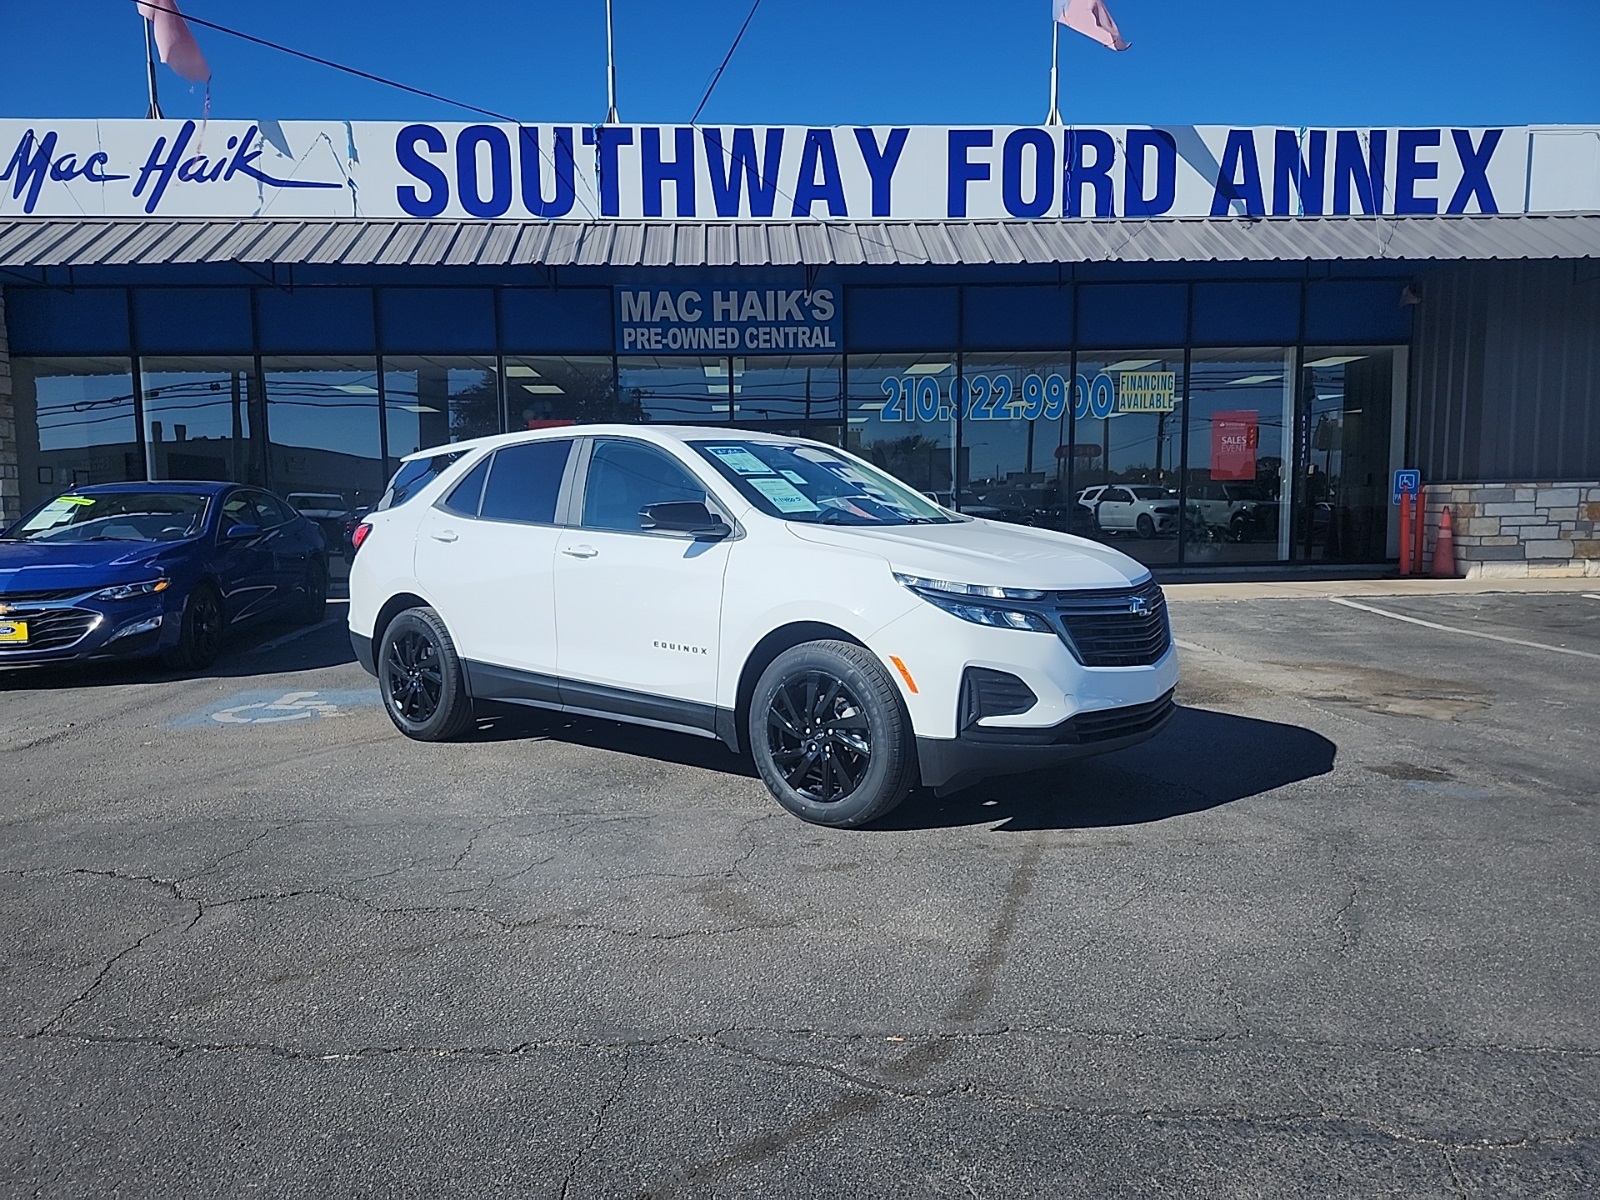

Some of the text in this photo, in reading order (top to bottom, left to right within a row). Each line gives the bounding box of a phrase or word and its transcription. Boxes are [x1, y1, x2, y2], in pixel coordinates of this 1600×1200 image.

[0, 120, 343, 214] Mac Haik
[396, 124, 1504, 218] SOUTHWAY FORD ANNEX
[620, 289, 835, 322] MAC HAIK'S
[623, 326, 836, 349] PRE-OWNED CENTRAL
[1121, 374, 1174, 391] FINANCING
[1120, 392, 1174, 409] AVAILABLE
[1221, 436, 1247, 445] SALES
[1221, 444, 1247, 453] EVENT
[653, 641, 707, 655] EQUINOX
